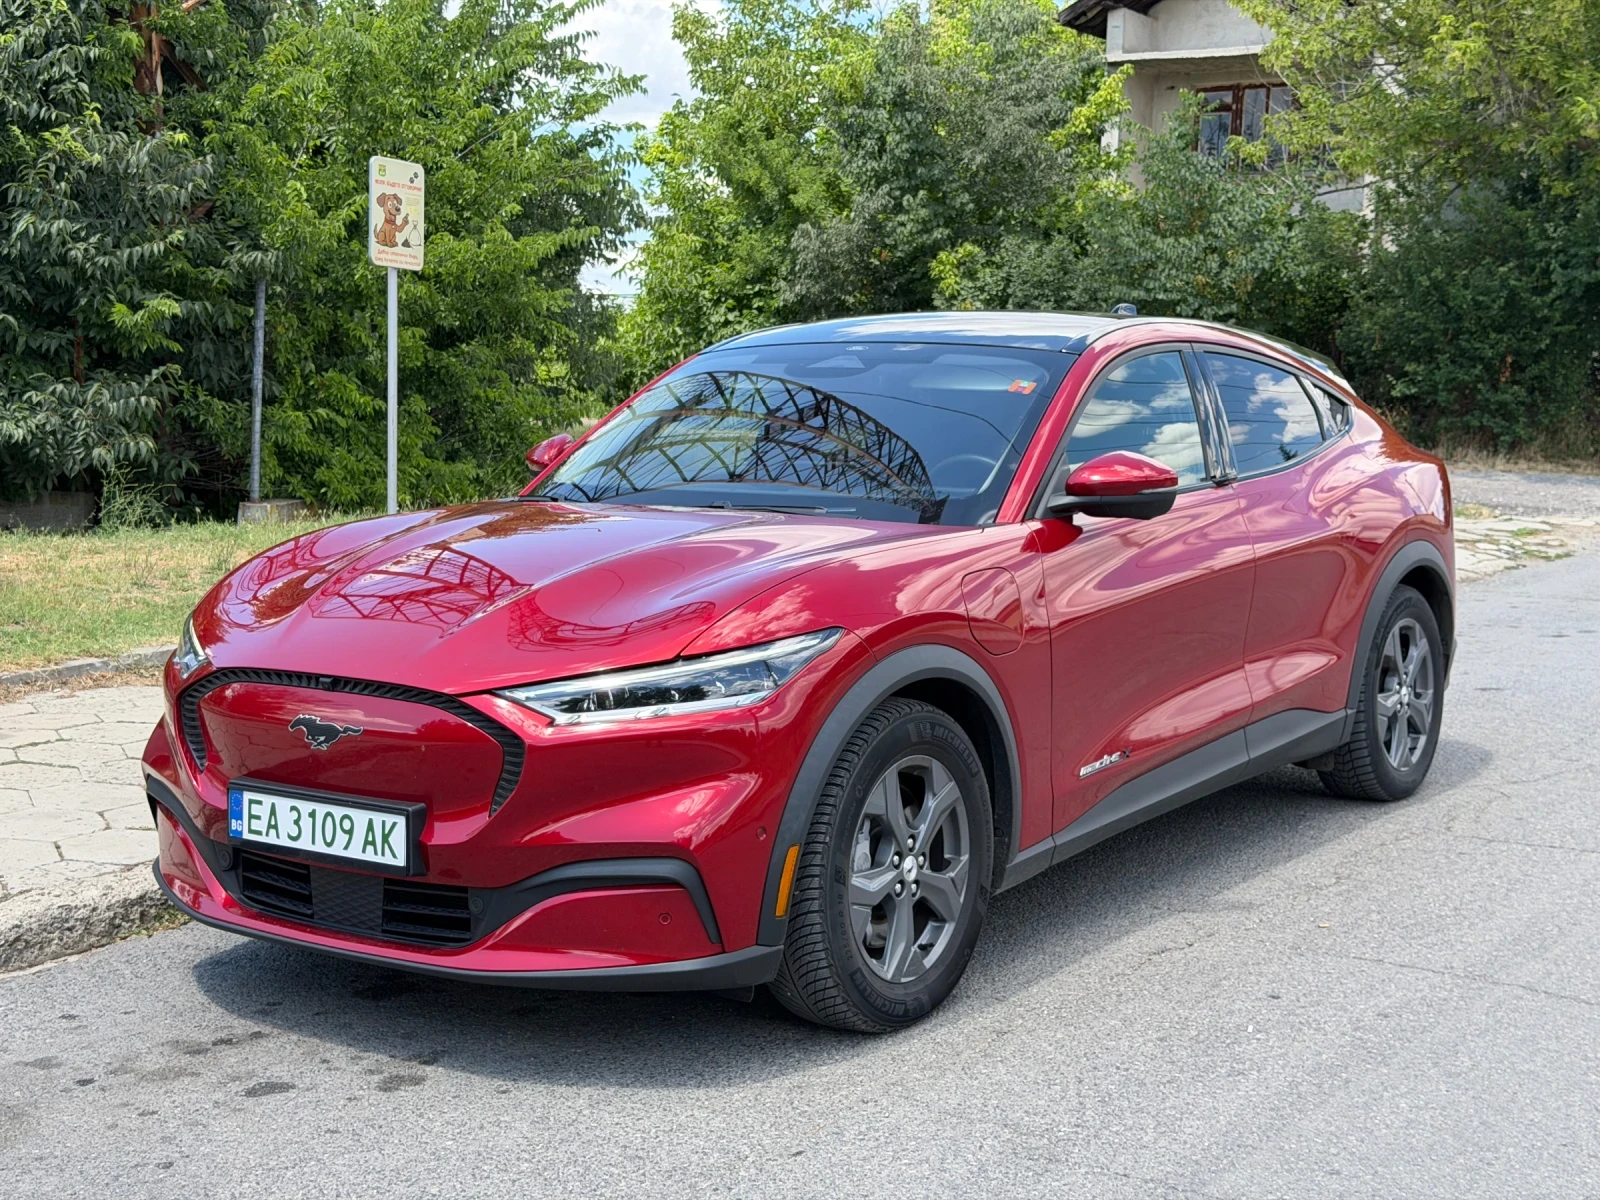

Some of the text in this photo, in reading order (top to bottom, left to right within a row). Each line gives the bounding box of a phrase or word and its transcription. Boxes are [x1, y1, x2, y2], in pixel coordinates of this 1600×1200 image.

[933, 724, 979, 774] MICHELIN
[231, 819, 242, 832] BG
[247, 798, 399, 860] EA 3109 AK
[852, 971, 906, 1016] MICHELIN
